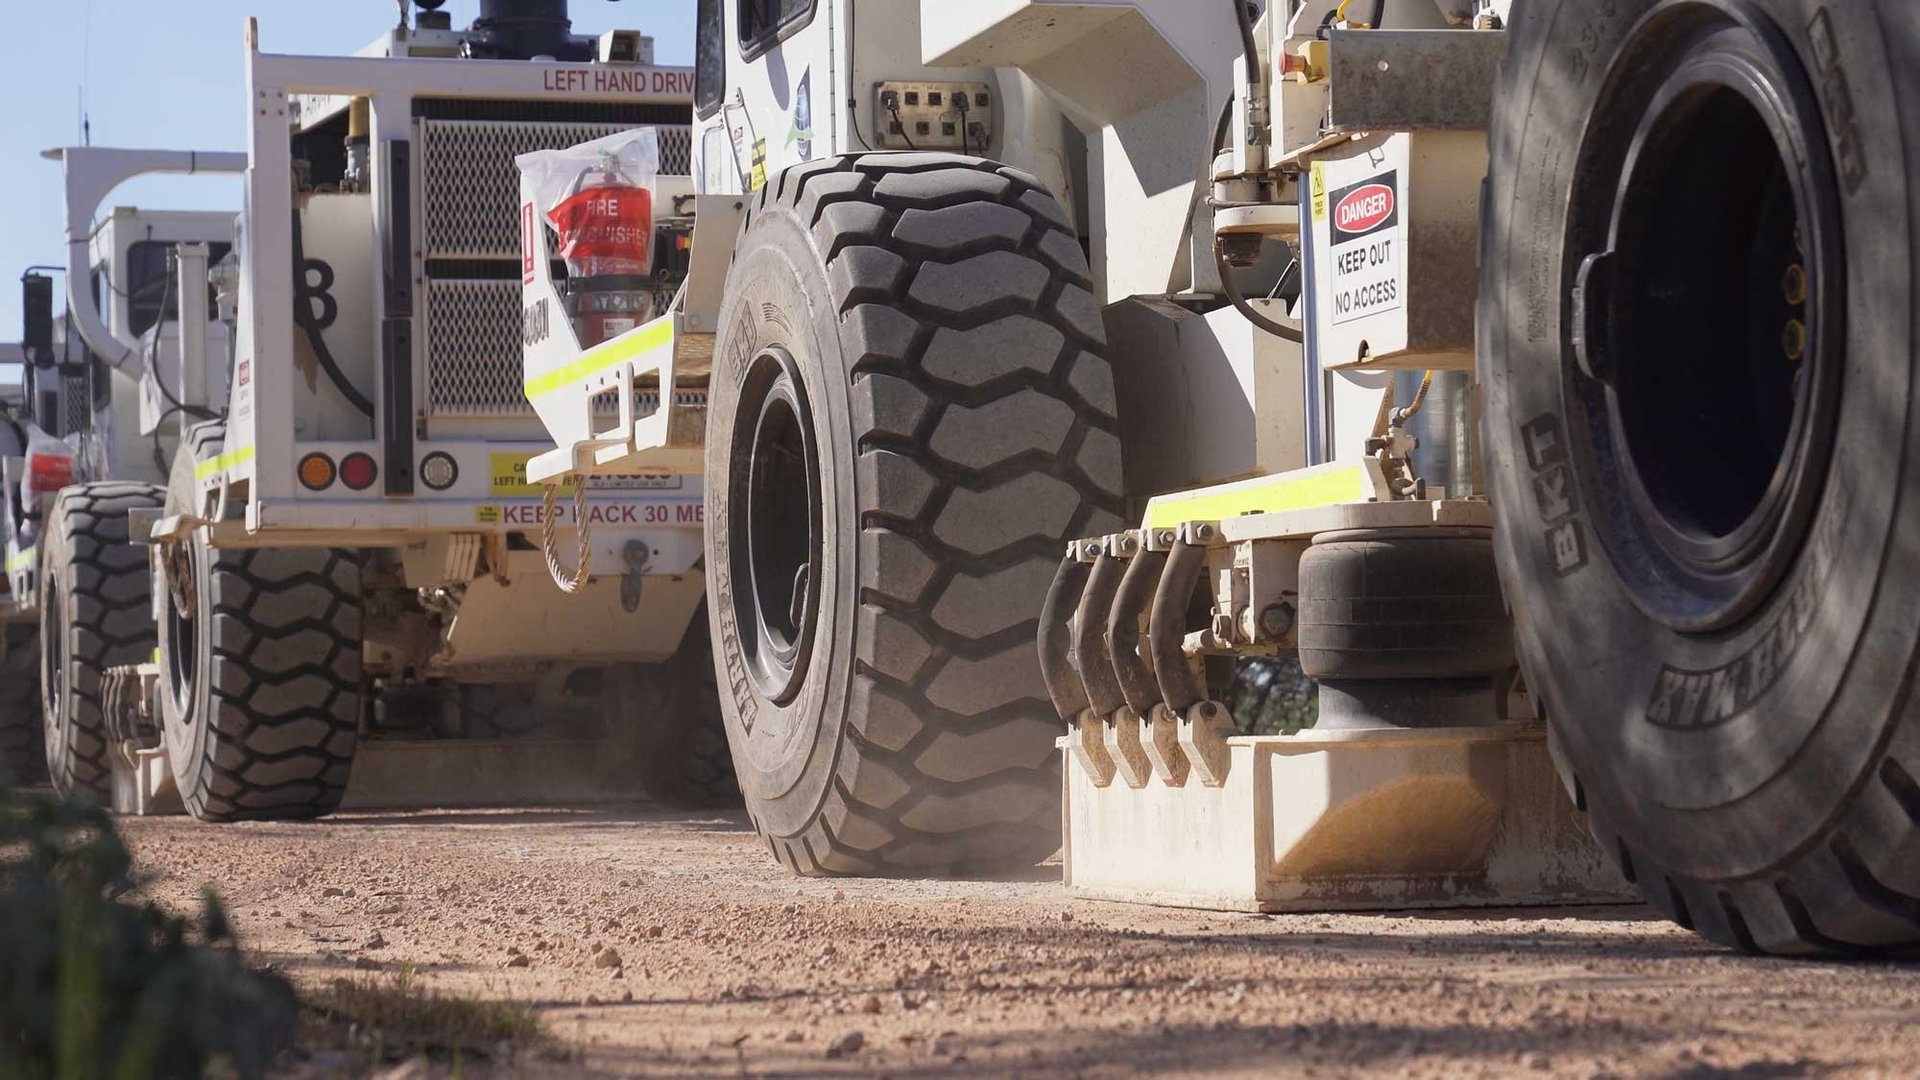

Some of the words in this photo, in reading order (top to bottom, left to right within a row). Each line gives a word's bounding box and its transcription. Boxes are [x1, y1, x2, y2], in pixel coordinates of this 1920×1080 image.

[544, 70, 588, 91] LEFT
[595, 72, 646, 92] HAND
[653, 73, 694, 93] DRIV
[586, 199, 618, 216] FIRE
[1341, 193, 1387, 225] DANGER
[1338, 248, 1366, 276] KEEP
[1369, 240, 1391, 266] OUT
[1335, 291, 1351, 315] NO
[1354, 278, 1396, 310] ACCESS
[494, 477, 515, 486] LEFT
[1525, 416, 1586, 575] BKT
[645, 505, 668, 522] 30
